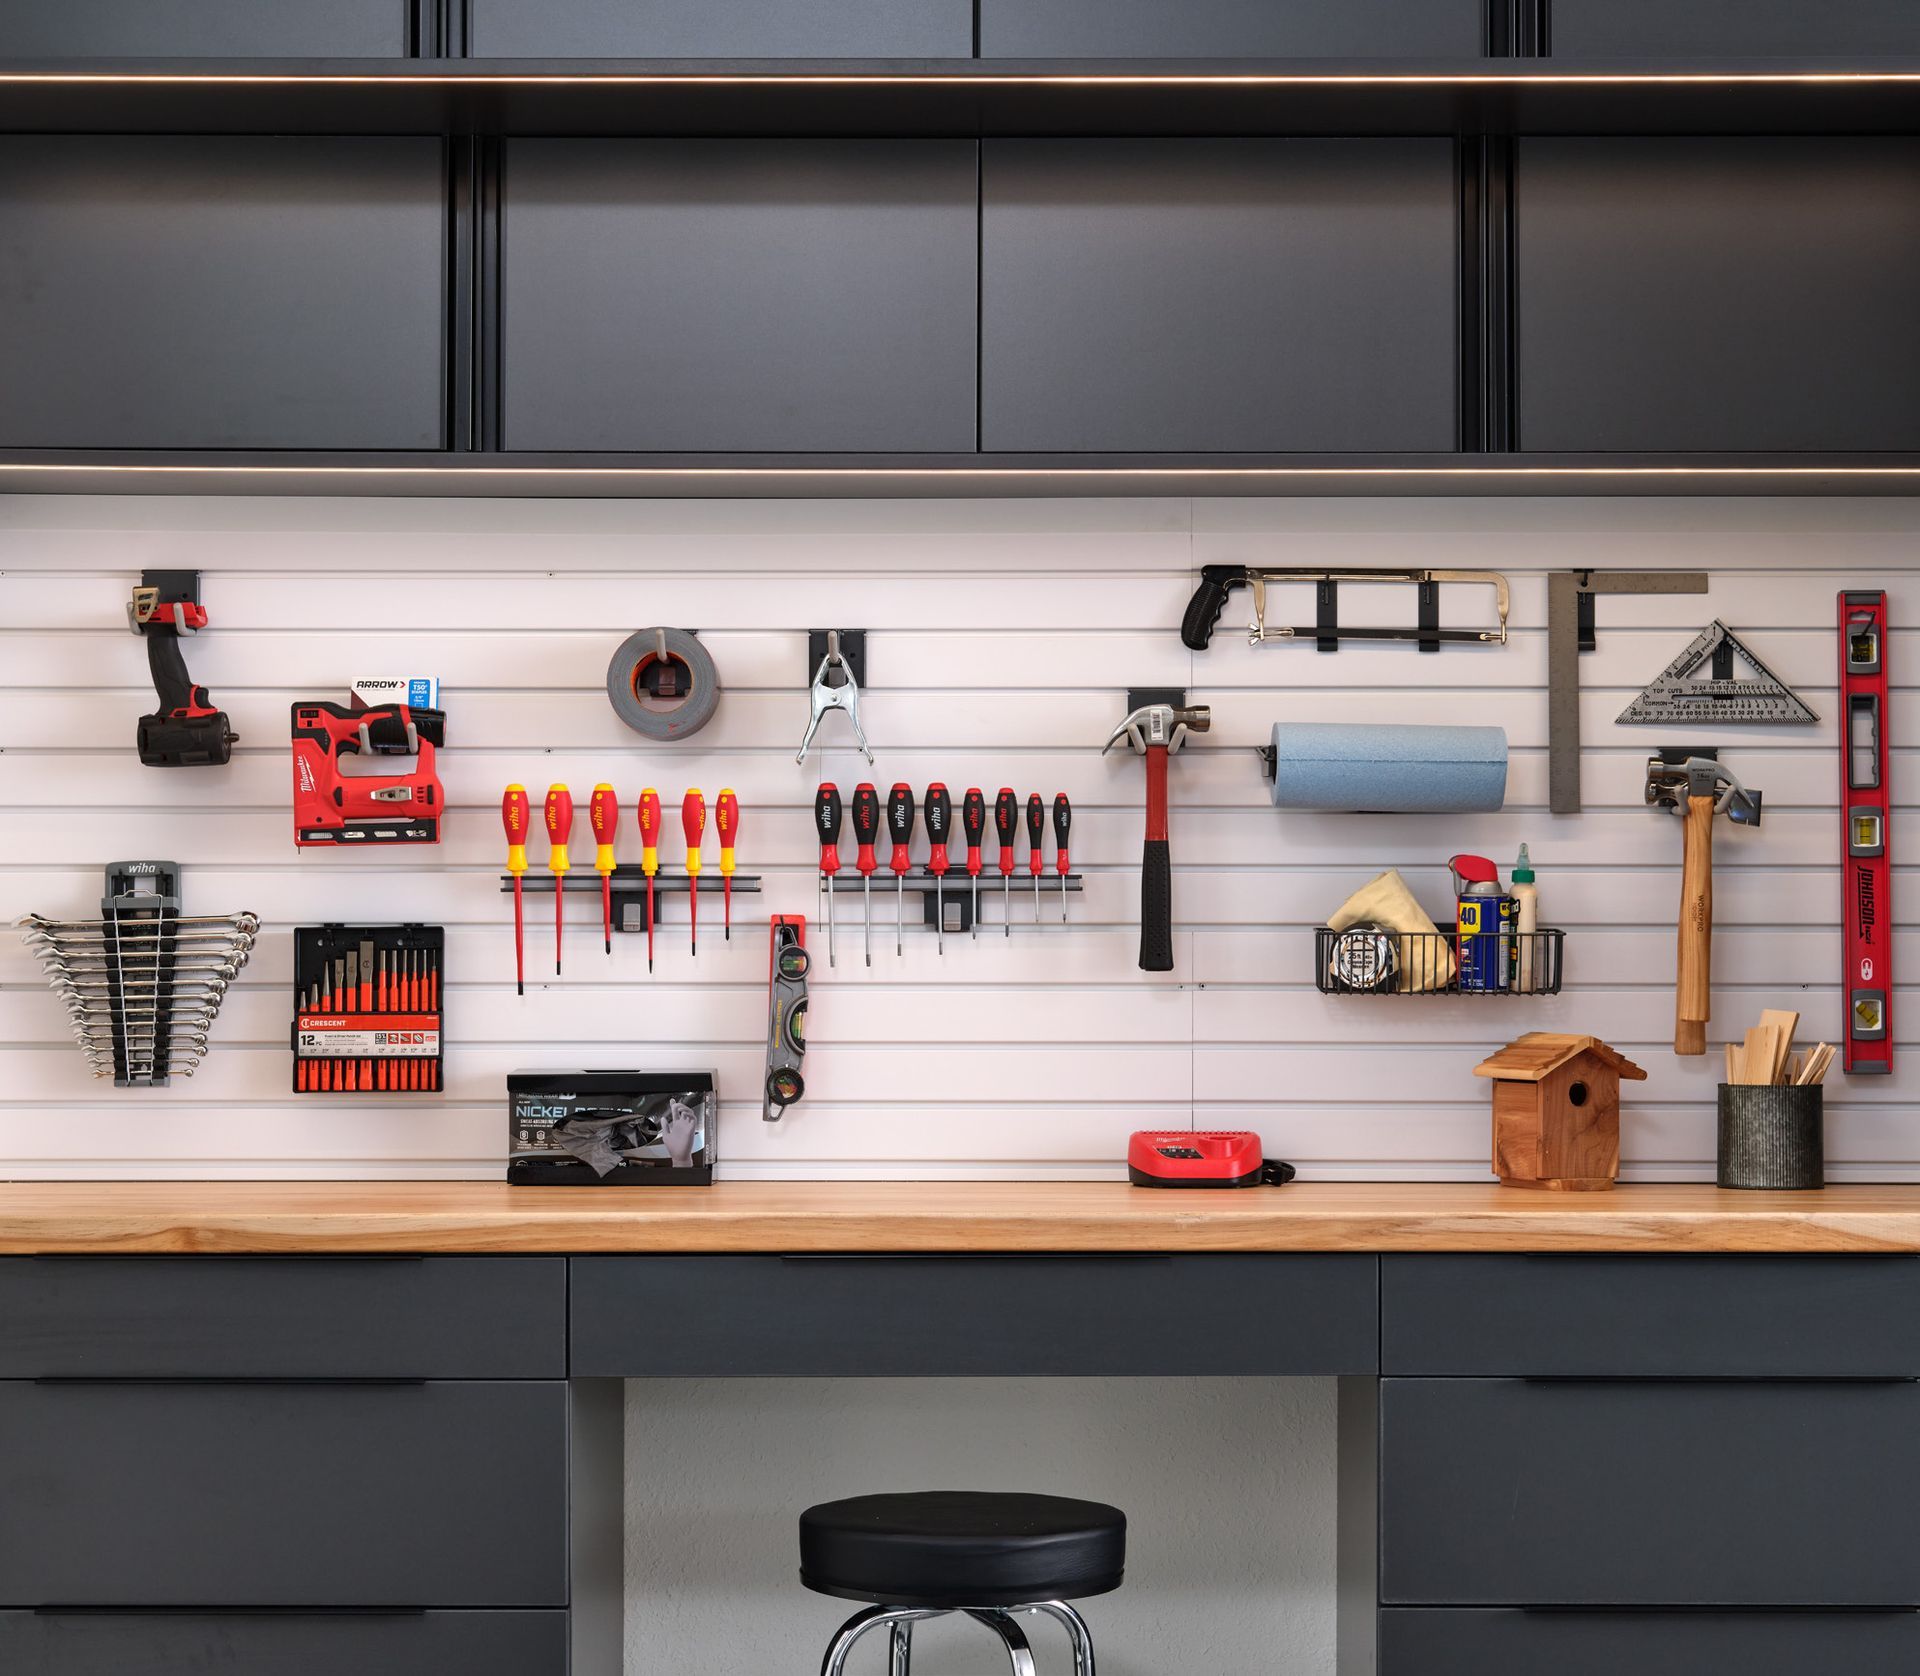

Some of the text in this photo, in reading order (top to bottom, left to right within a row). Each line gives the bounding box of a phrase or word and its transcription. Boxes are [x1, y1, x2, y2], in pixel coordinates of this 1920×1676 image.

[1701, 638, 1715, 652] PIVOT
[297, 755, 312, 792] Milwaukee
[509, 806, 519, 830] wiha
[547, 806, 557, 829] wiha
[594, 806, 603, 829] wiha
[642, 809, 650, 830] wiha
[719, 810, 727, 830] wiha
[821, 806, 831, 829] wiha
[860, 806, 870, 829] wiha
[895, 805, 905, 828] wiha
[931, 807, 941, 830] wiha
[969, 808, 978, 829] wiha
[128, 862, 156, 873] wiha
[1857, 865, 1875, 926] JOHNSON
[1461, 907, 1477, 925] 40
[301, 1035, 315, 1046] 12
